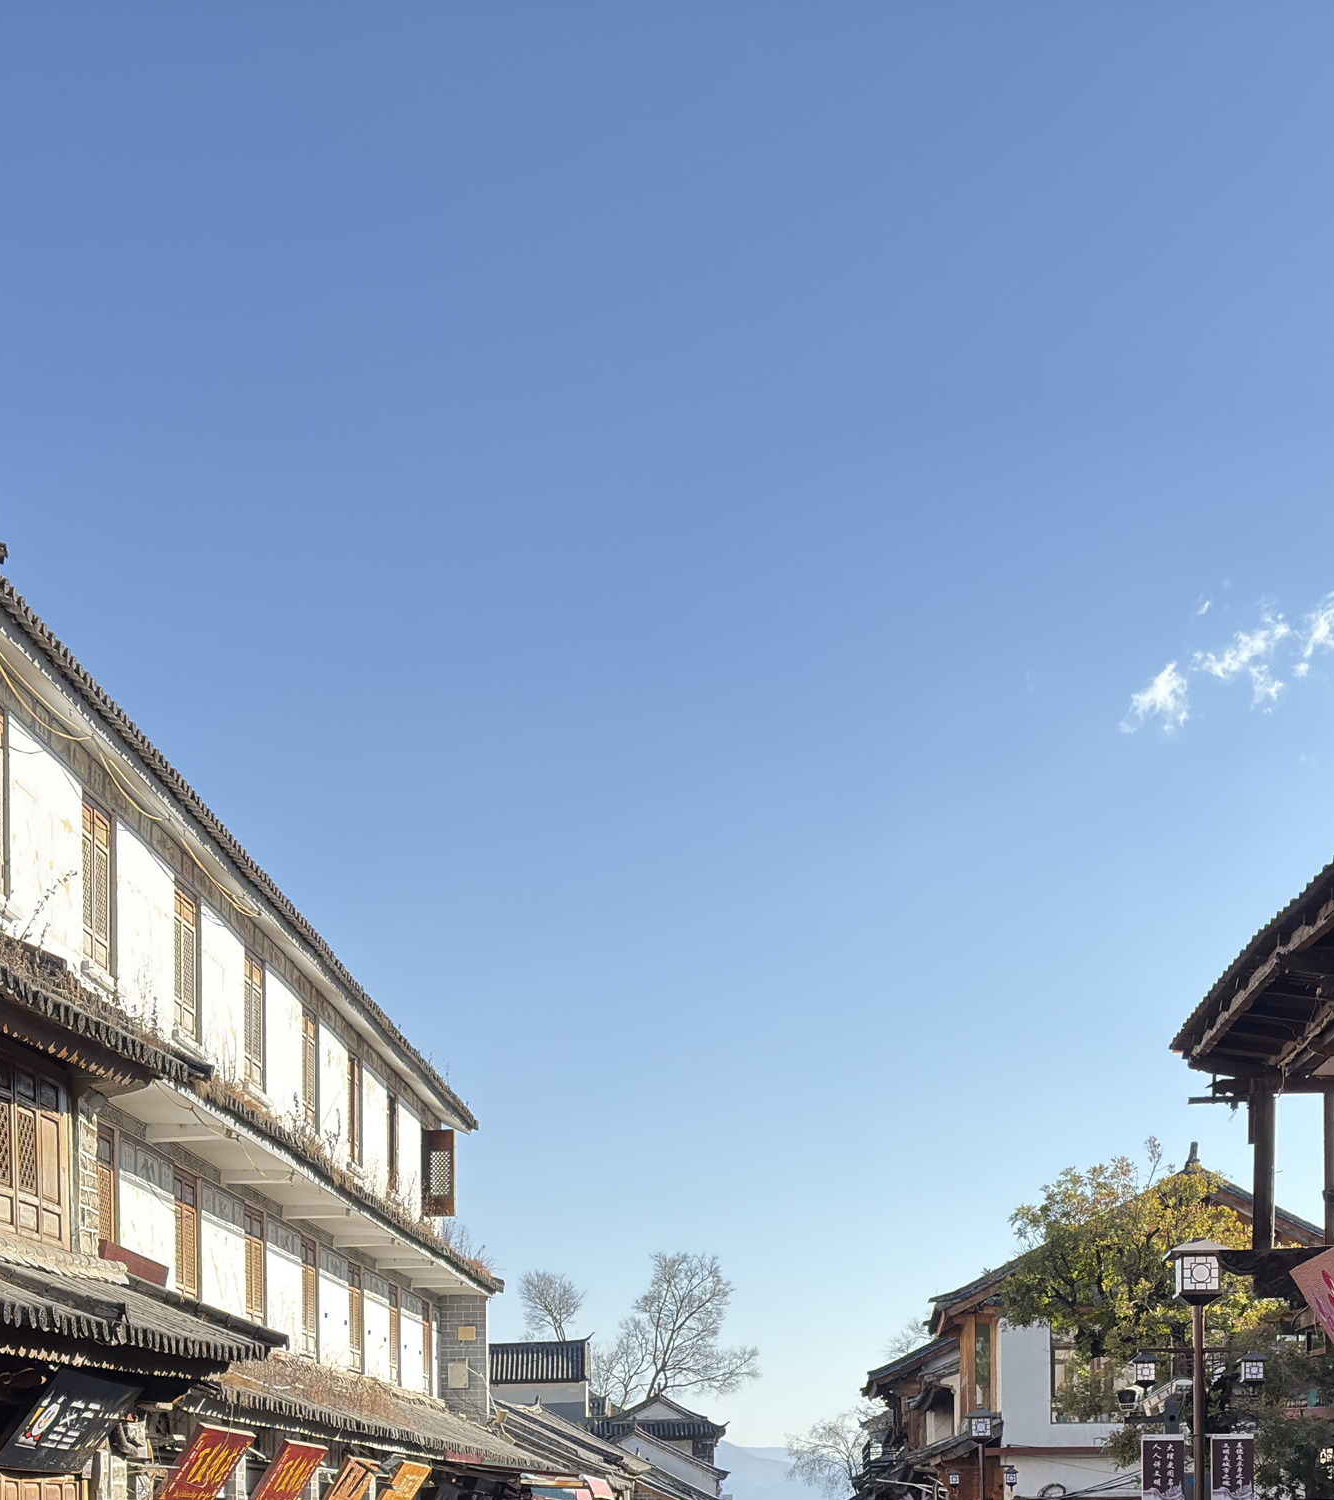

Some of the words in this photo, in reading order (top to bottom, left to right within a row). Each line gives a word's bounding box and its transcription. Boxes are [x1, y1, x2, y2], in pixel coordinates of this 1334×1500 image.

[1152, 1443, 1163, 1487] 人人讲文明
